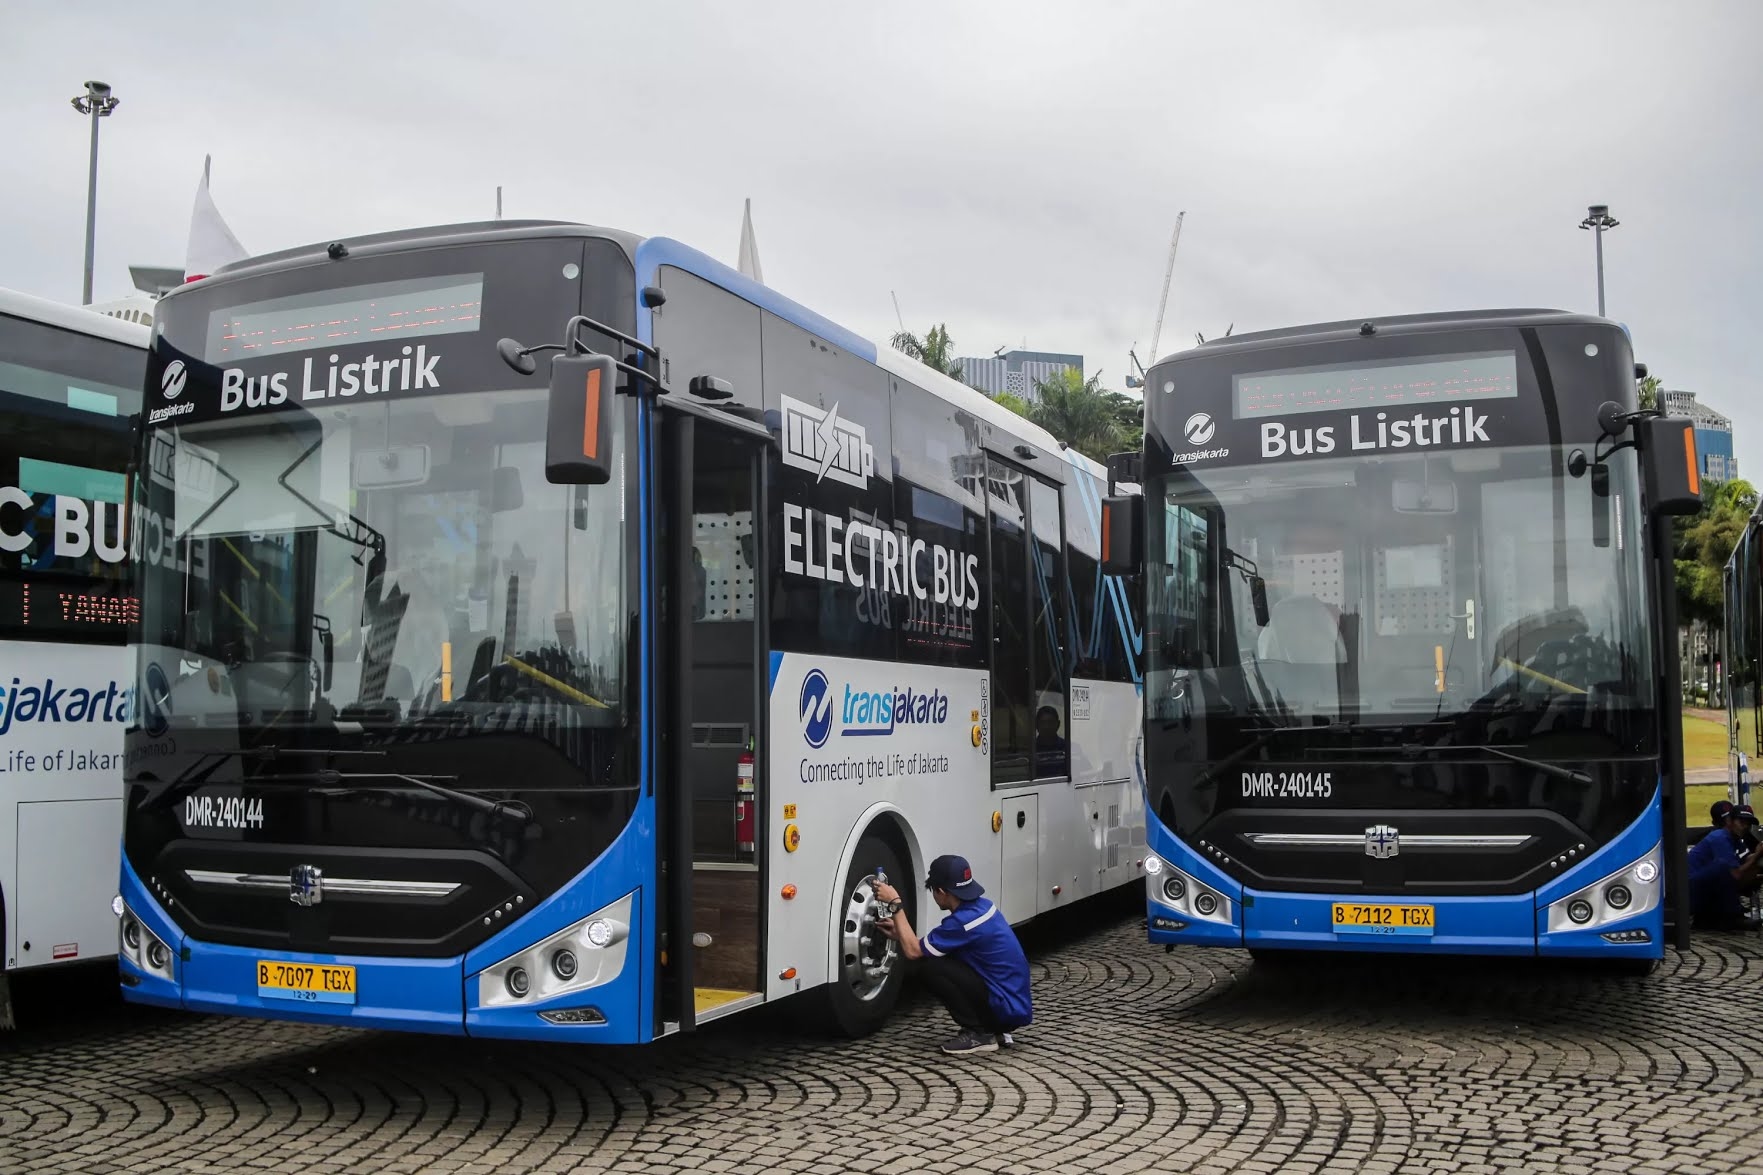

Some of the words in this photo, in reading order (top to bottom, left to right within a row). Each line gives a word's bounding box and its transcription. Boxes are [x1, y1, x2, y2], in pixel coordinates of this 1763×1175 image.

[220, 368, 288, 412] Bus
[302, 344, 441, 401] Listrik
[148, 402, 195, 424] transjakarta
[1261, 422, 1336, 458] Bus
[1350, 406, 1490, 451] Listrik
[1172, 447, 1229, 466] transjakarta
[783, 502, 927, 600] ELECTRIC
[934, 544, 980, 611] BUS
[841, 683, 948, 736] transjakarta
[0, 750, 35, 772] ife
[43, 750, 63, 771] of
[68, 750, 124, 771] Jakar
[800, 756, 864, 785] Connecting
[867, 756, 884, 779] the
[886, 753, 904, 777] Life
[907, 753, 917, 775] of
[918, 753, 949, 775] Jakarta
[1241, 772, 1332, 797] DMR-240145
[185, 795, 264, 829] DMR-240144
[1335, 906, 1345, 923] B
[1353, 907, 1392, 924] 7112
[1401, 908, 1430, 925] TGX
[260, 964, 269, 985] B
[277, 965, 314, 988] 7097
[322, 968, 351, 991] TGX
